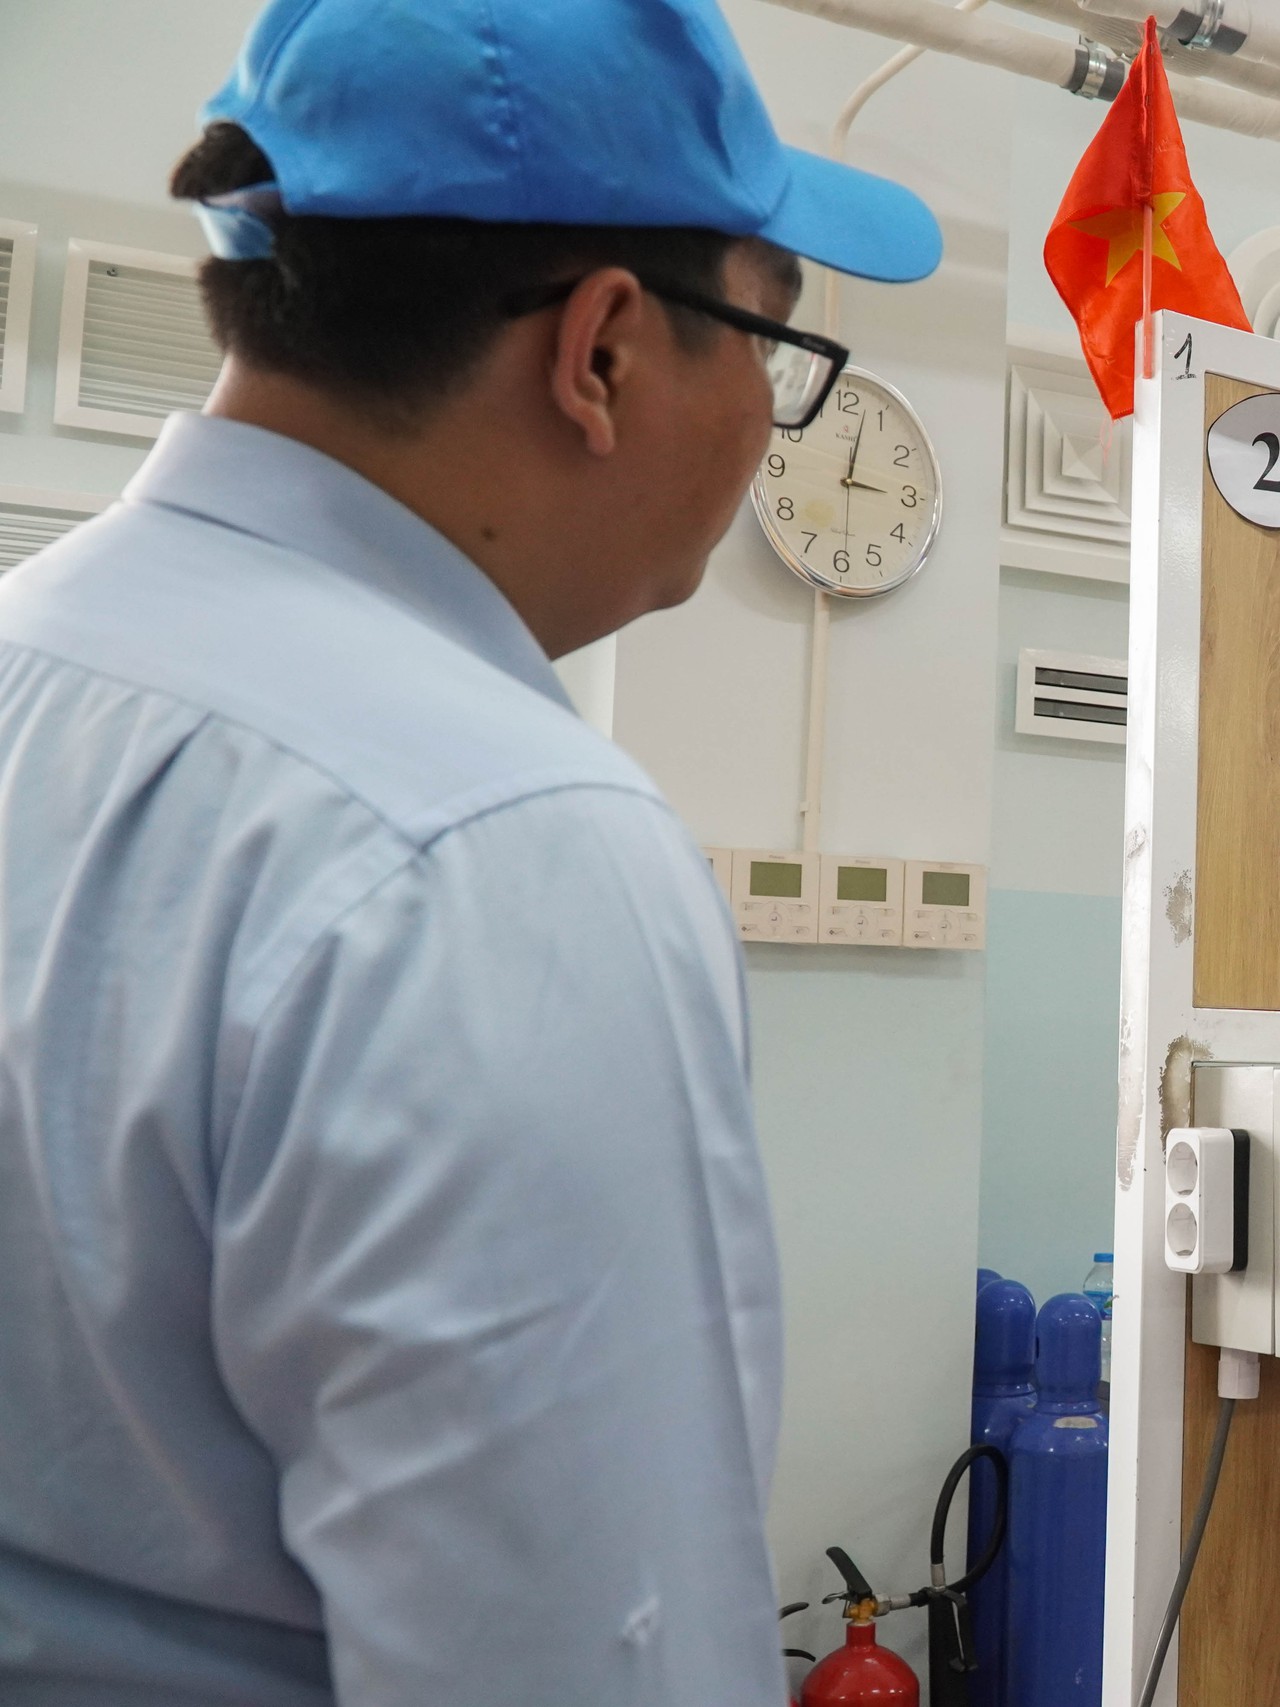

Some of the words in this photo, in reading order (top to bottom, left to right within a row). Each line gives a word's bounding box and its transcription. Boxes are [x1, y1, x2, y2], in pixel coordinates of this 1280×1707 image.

[1173, 332, 1197, 380] 1
[835, 389, 860, 415] 12
[877, 410, 883, 431] 1
[767, 454, 785, 478] 9
[893, 445, 910, 468] 2
[900, 485, 917, 508] 3
[776, 497, 795, 521] 8
[801, 531, 817, 553] 7
[889, 523, 906, 544] 4
[833, 550, 850, 573] 6
[865, 544, 882, 566] 5
